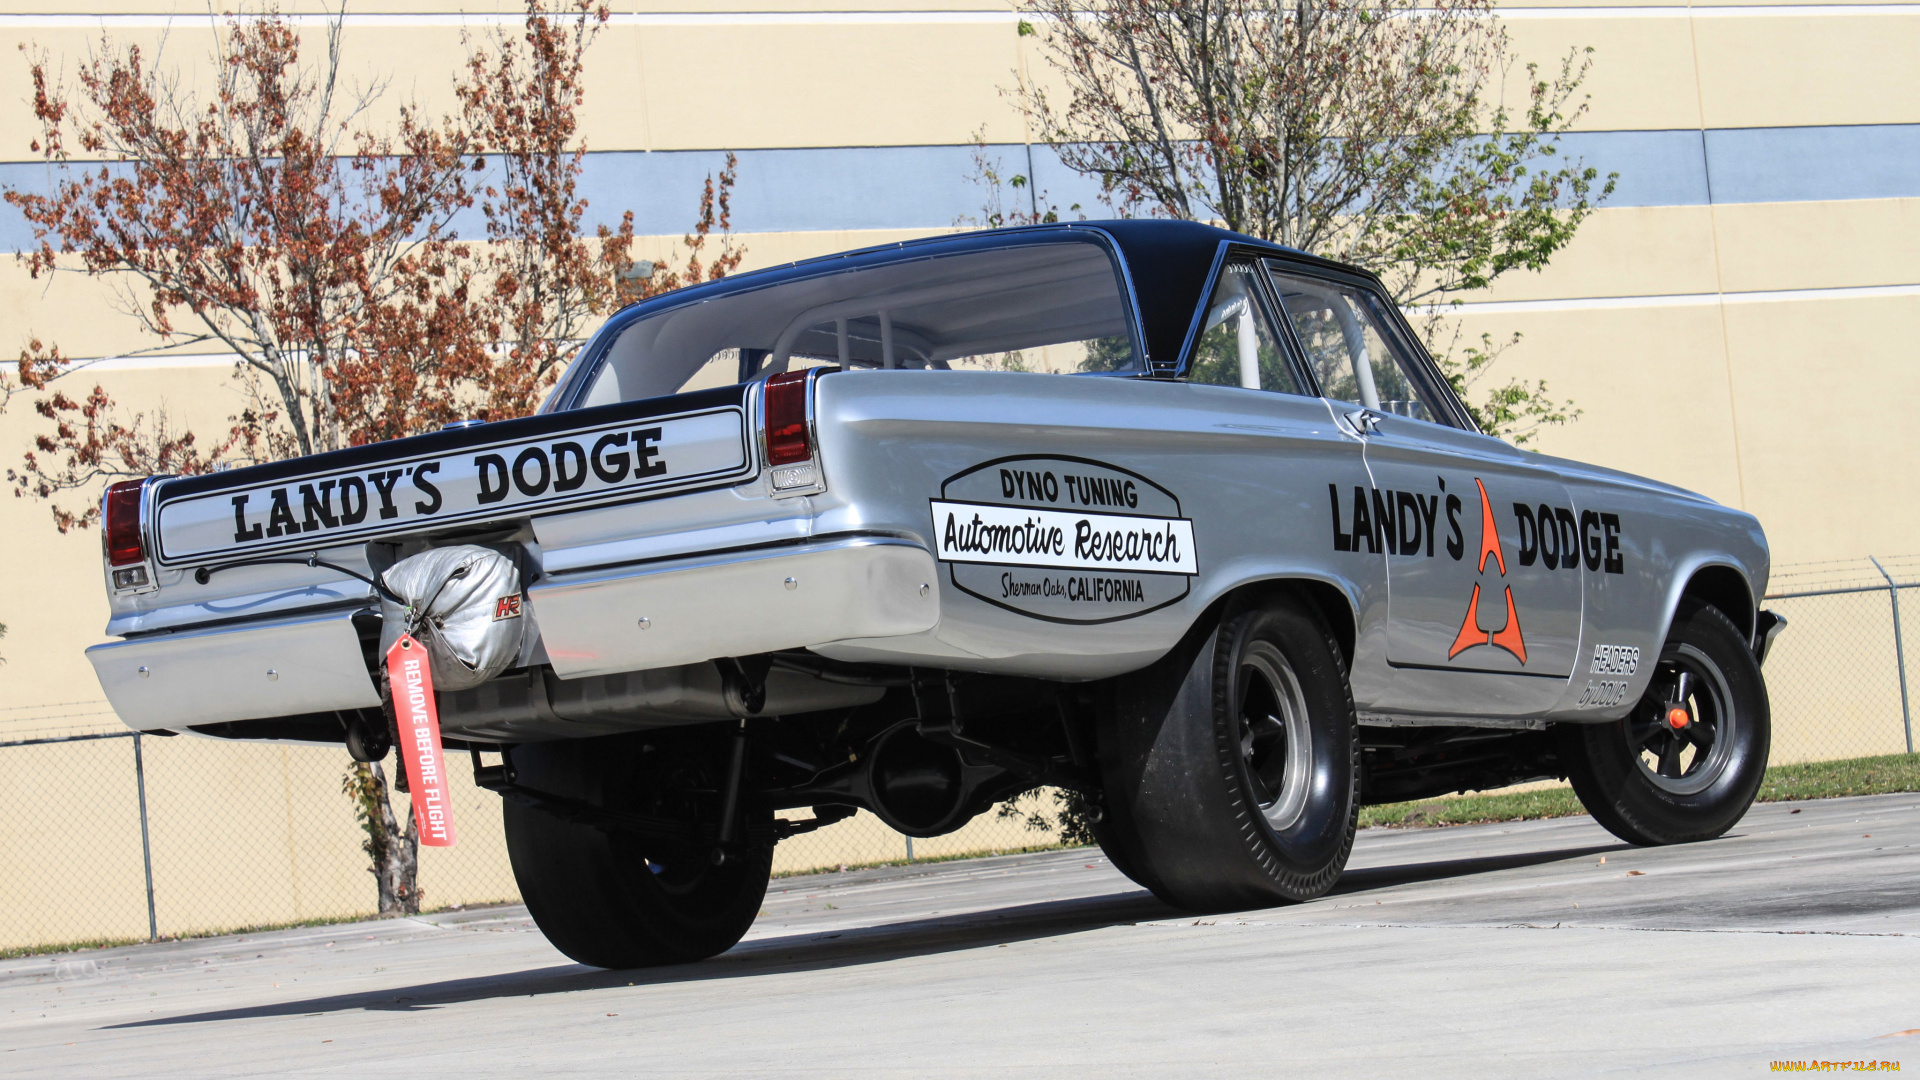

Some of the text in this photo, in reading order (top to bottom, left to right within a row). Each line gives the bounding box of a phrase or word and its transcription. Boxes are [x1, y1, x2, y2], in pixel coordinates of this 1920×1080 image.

[231, 427, 667, 542] LANDY'S DODGE
[1000, 469, 1138, 508] DYNO TUNING
[944, 512, 1180, 563] Automotive Research
[1328, 475, 1624, 574] LANDY'S DODGE
[1001, 572, 1042, 597] Sherman
[1067, 577, 1144, 602] CALIFORNIA
[1590, 644, 1639, 675] HEADERS
[404, 659, 447, 841] REMOVE BEFORE FLIGHT
